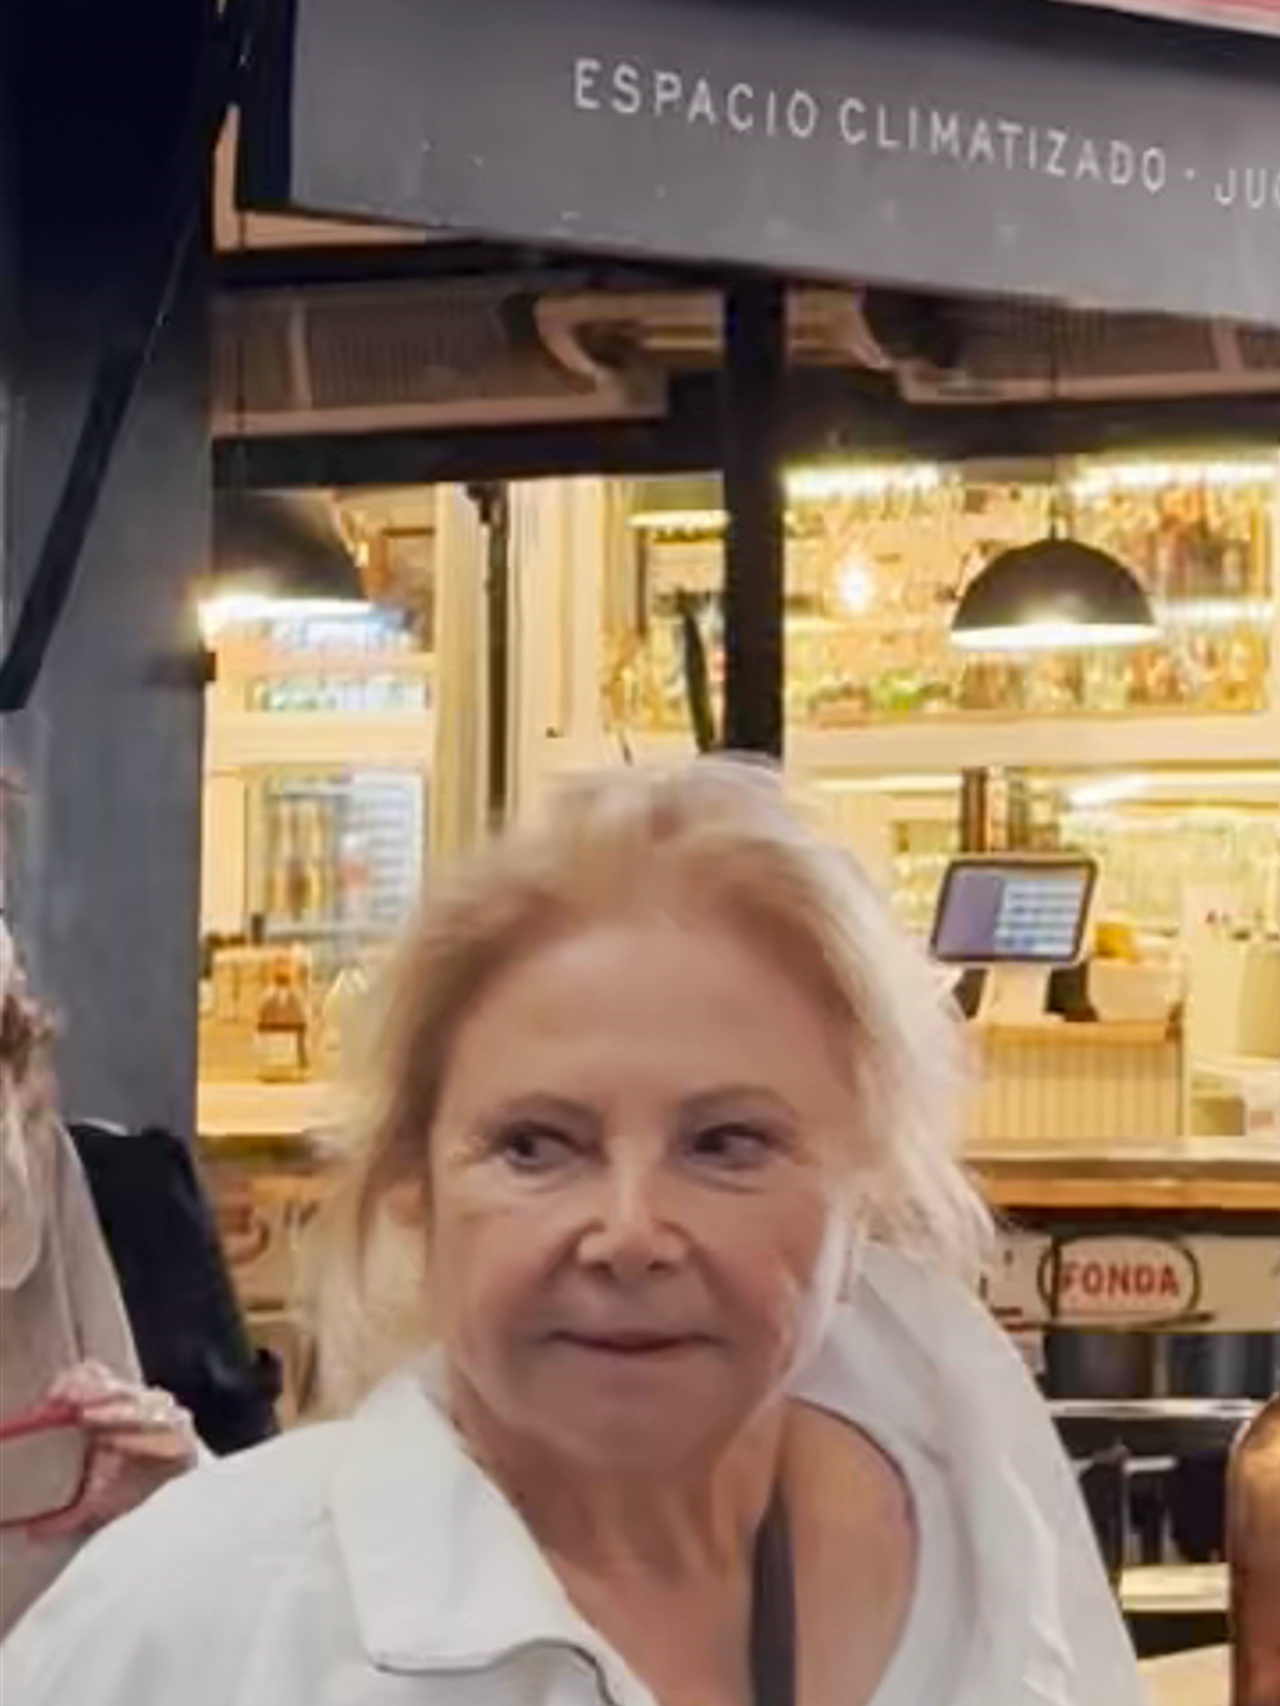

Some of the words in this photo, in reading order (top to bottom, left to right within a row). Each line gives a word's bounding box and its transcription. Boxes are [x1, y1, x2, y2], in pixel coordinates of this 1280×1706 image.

[573, 57, 820, 140] ESPACIO
[837, 96, 1168, 193] CLIMATIZADO
[1059, 1260, 1180, 1299] FONDA
